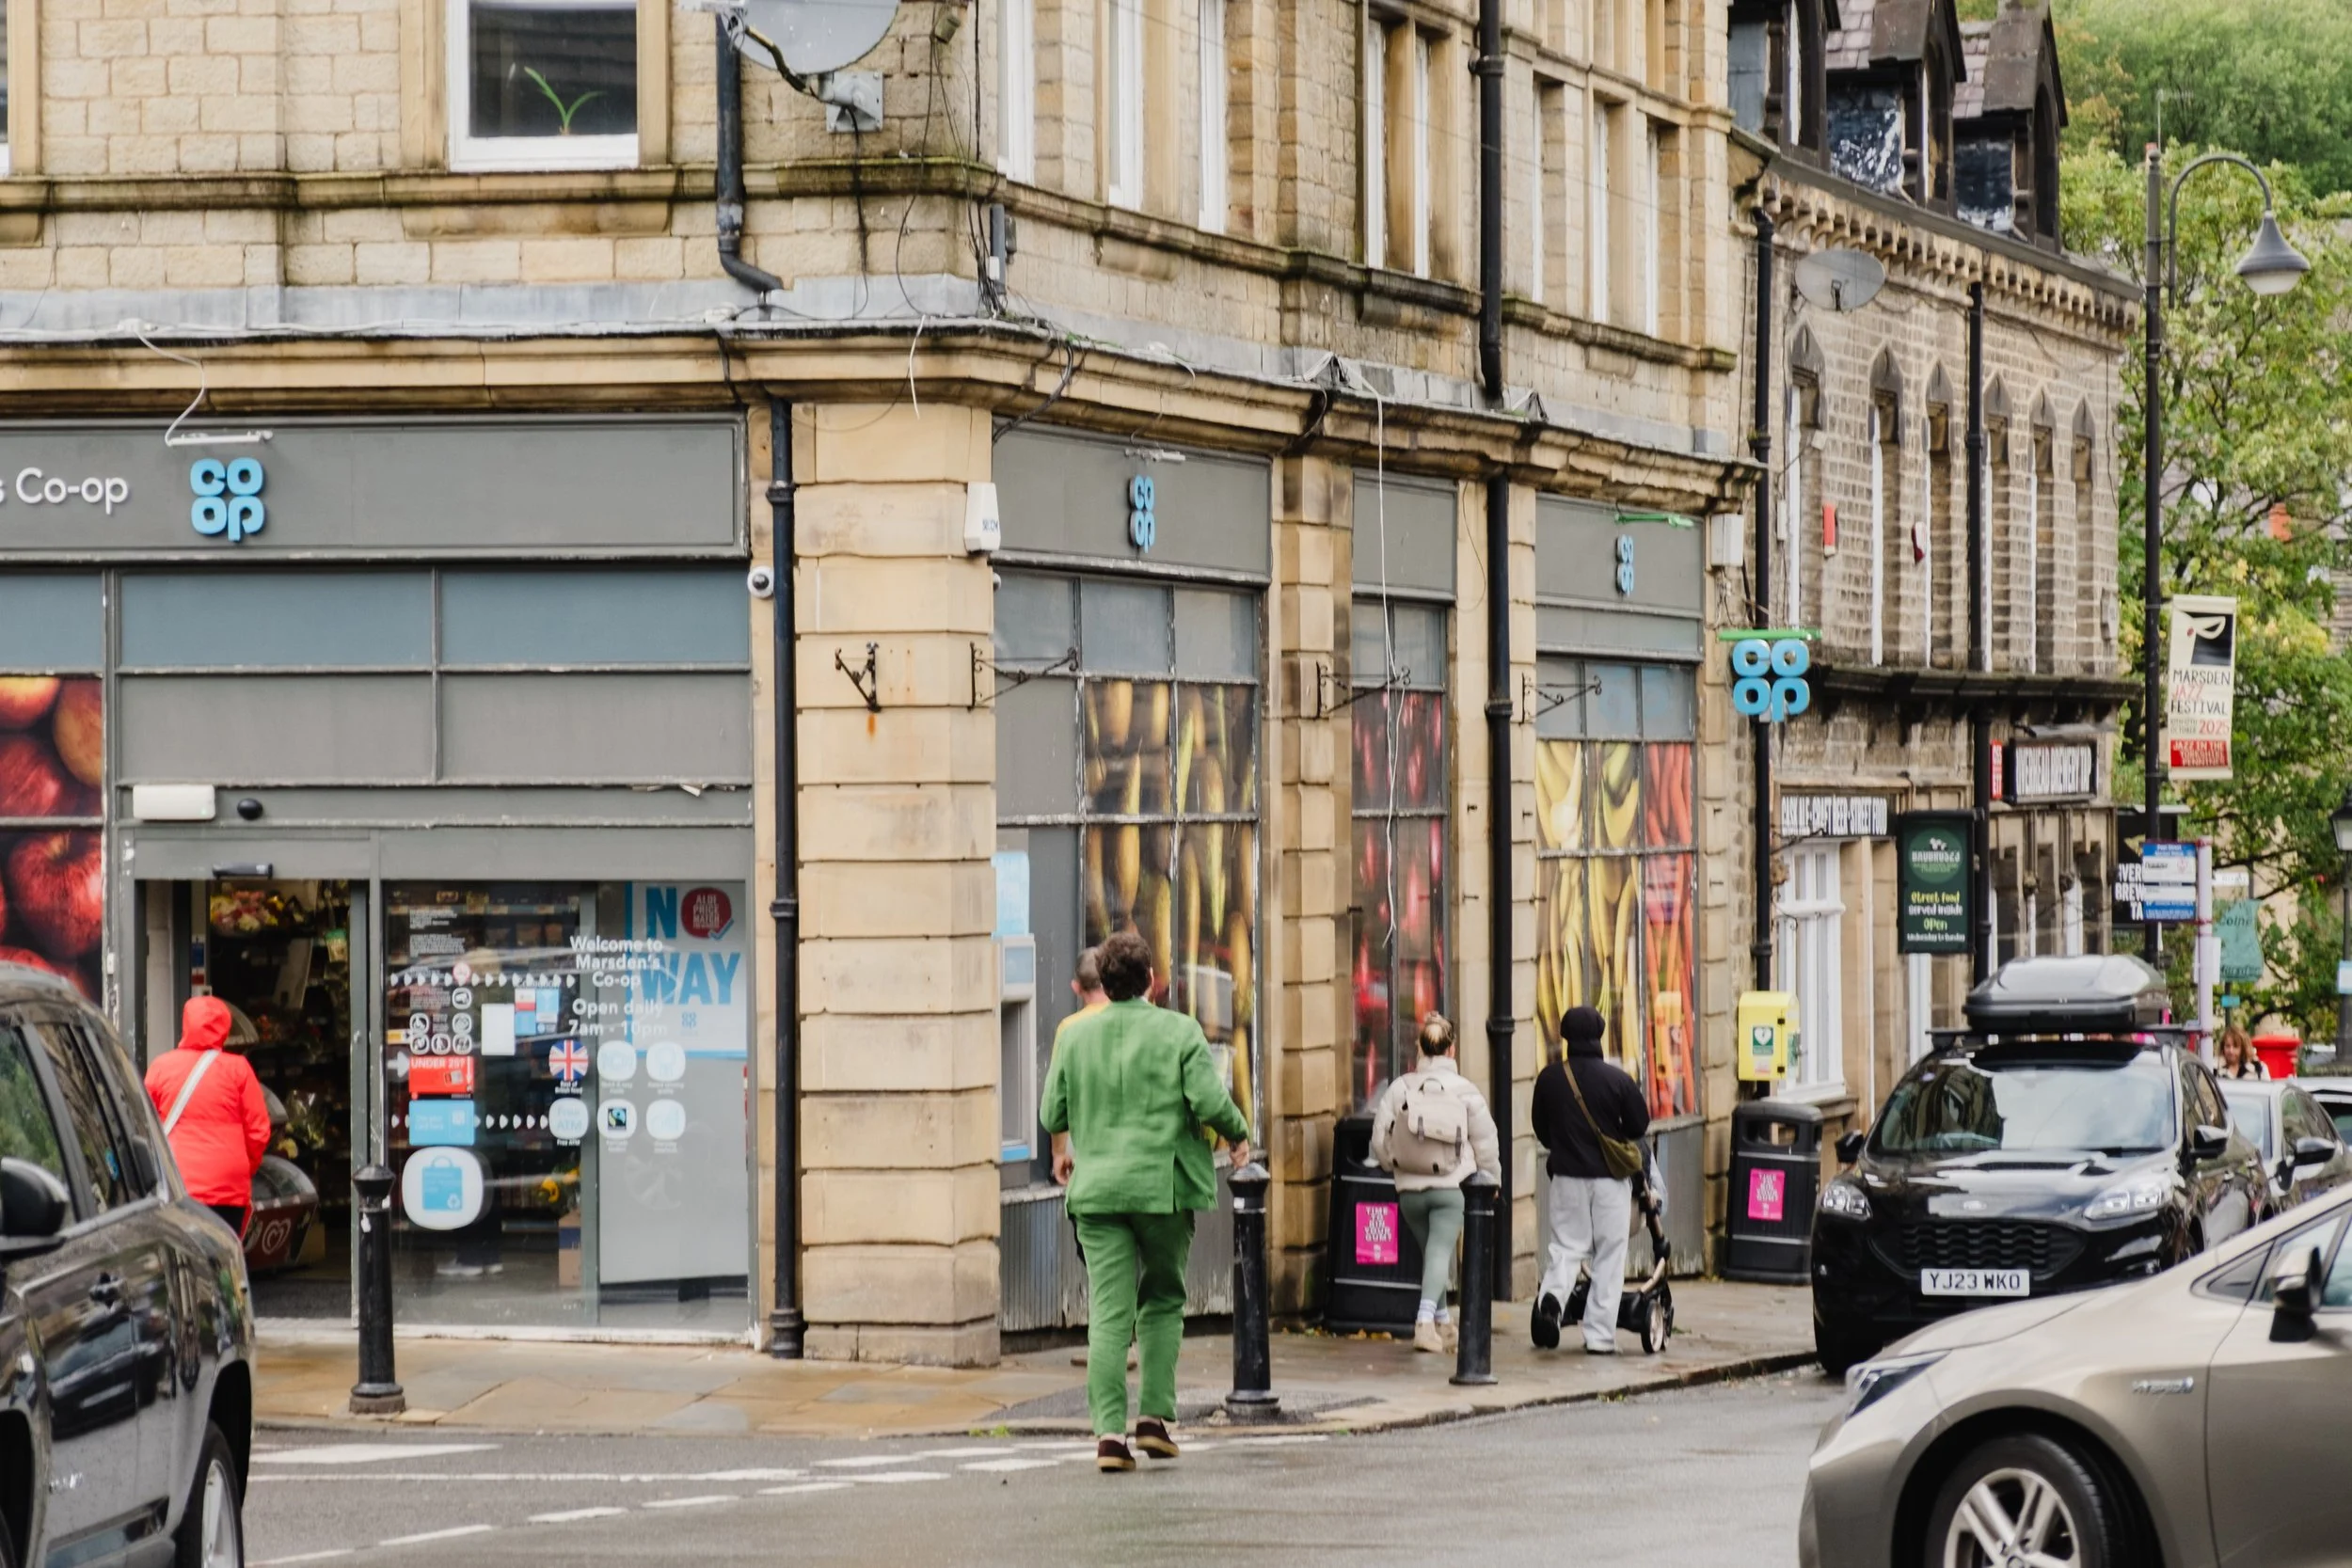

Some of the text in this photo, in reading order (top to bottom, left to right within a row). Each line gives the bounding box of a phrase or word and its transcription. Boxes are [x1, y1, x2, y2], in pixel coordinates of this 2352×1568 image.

[15, 467, 128, 515] Co-op
[2172, 669, 2231, 686] MARSDEN
[2171, 684, 2204, 701] JAZZ
[2170, 700, 2227, 715] FESTIVAL
[2199, 719, 2230, 736] 2025
[1850, 797, 1872, 835] STREET
[1872, 797, 1887, 835] FOOD
[695, 894, 717, 904] ALDI
[2115, 882, 2145, 901] BREW
[692, 904, 720, 914] PRICE
[2130, 901, 2144, 920] TA
[569, 935, 663, 952] Welcome to
[575, 953, 660, 970] Marsden's
[592, 971, 641, 990] Co-op
[638, 951, 741, 1006] WAY
[572, 999, 663, 1019] Open daily
[568, 1019, 604, 1037] 7am
[620, 1020, 668, 1038] 10pm
[410, 1058, 447, 1069] UNDER
[1930, 1273, 2021, 1291] YJ23 WKO
